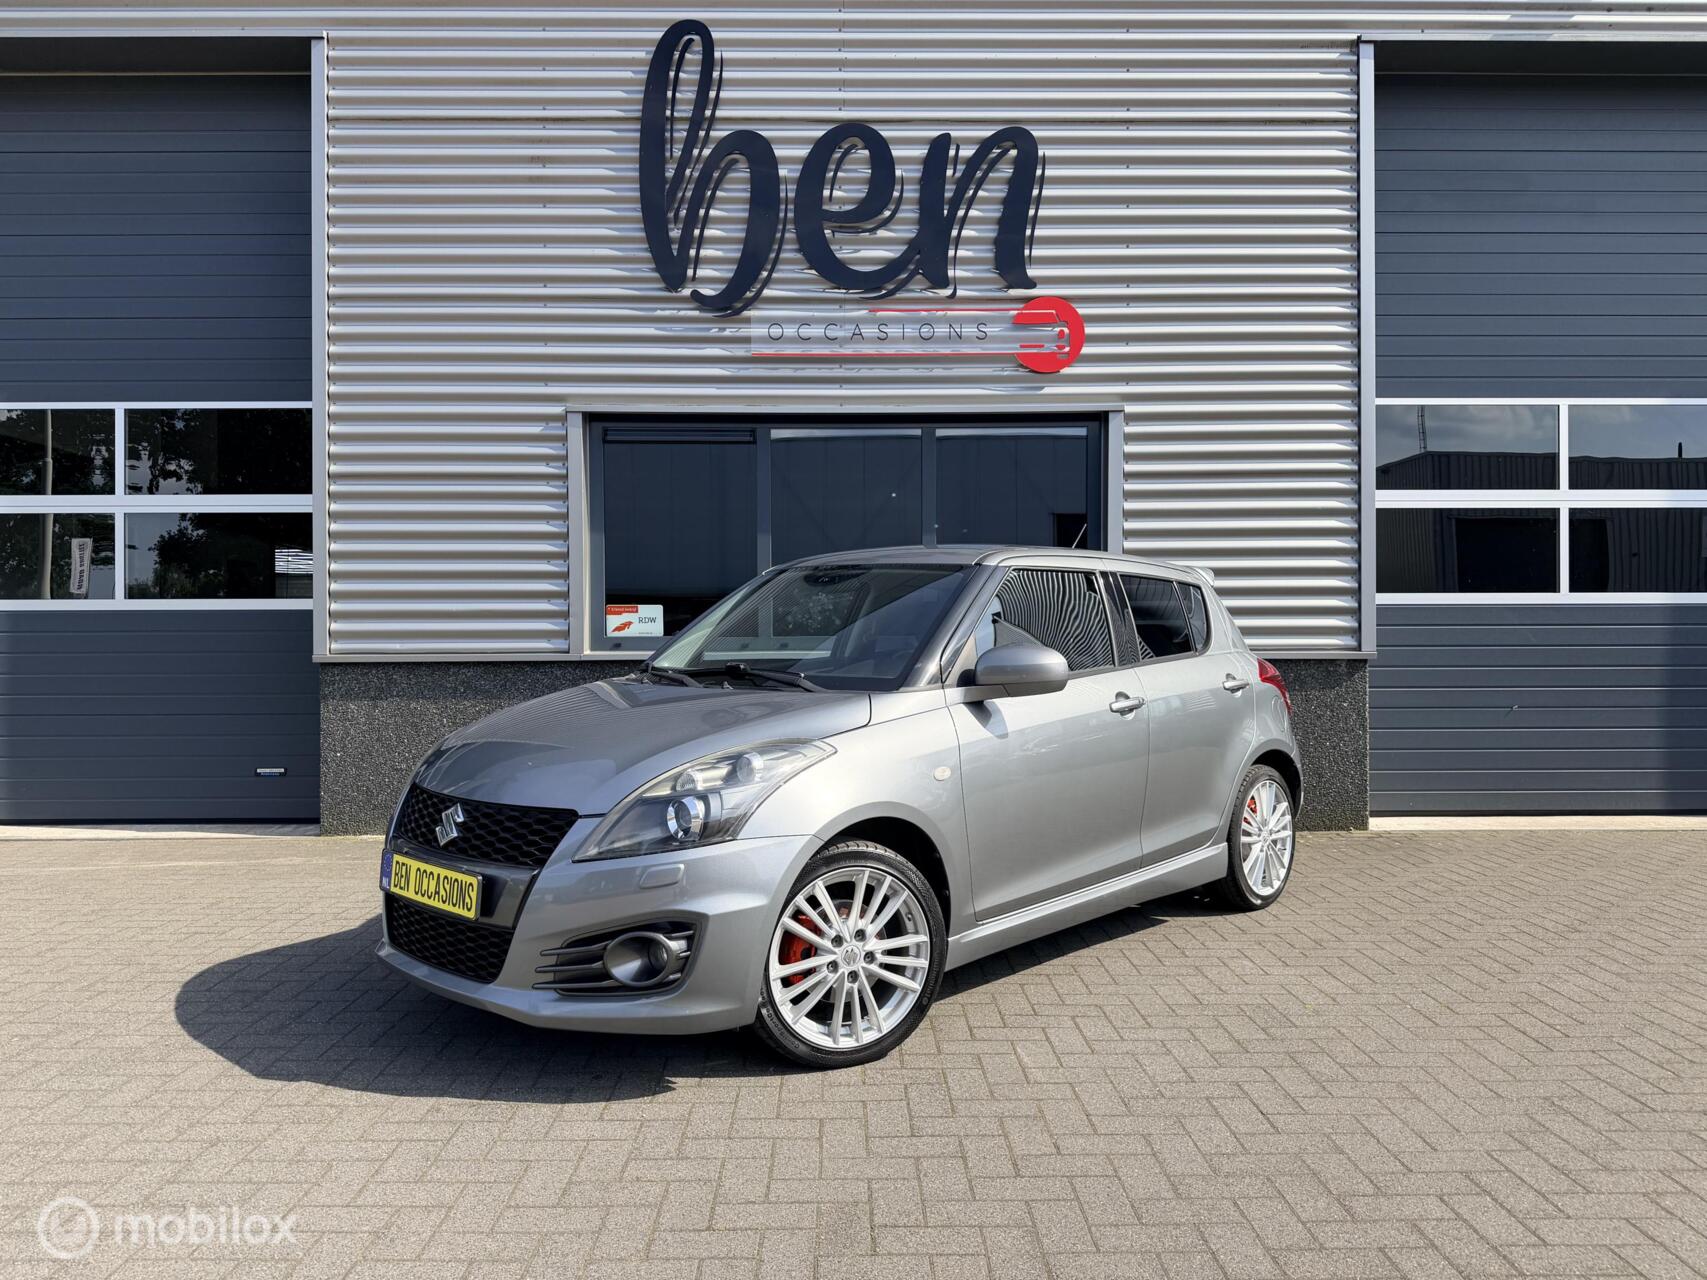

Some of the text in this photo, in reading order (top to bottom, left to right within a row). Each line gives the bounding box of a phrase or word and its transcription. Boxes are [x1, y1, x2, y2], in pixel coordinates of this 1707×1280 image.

[639, 19, 1045, 317] ben
[767, 322, 988, 341] OCCASIONS
[393, 860, 474, 912] BEN OCCASIONS
